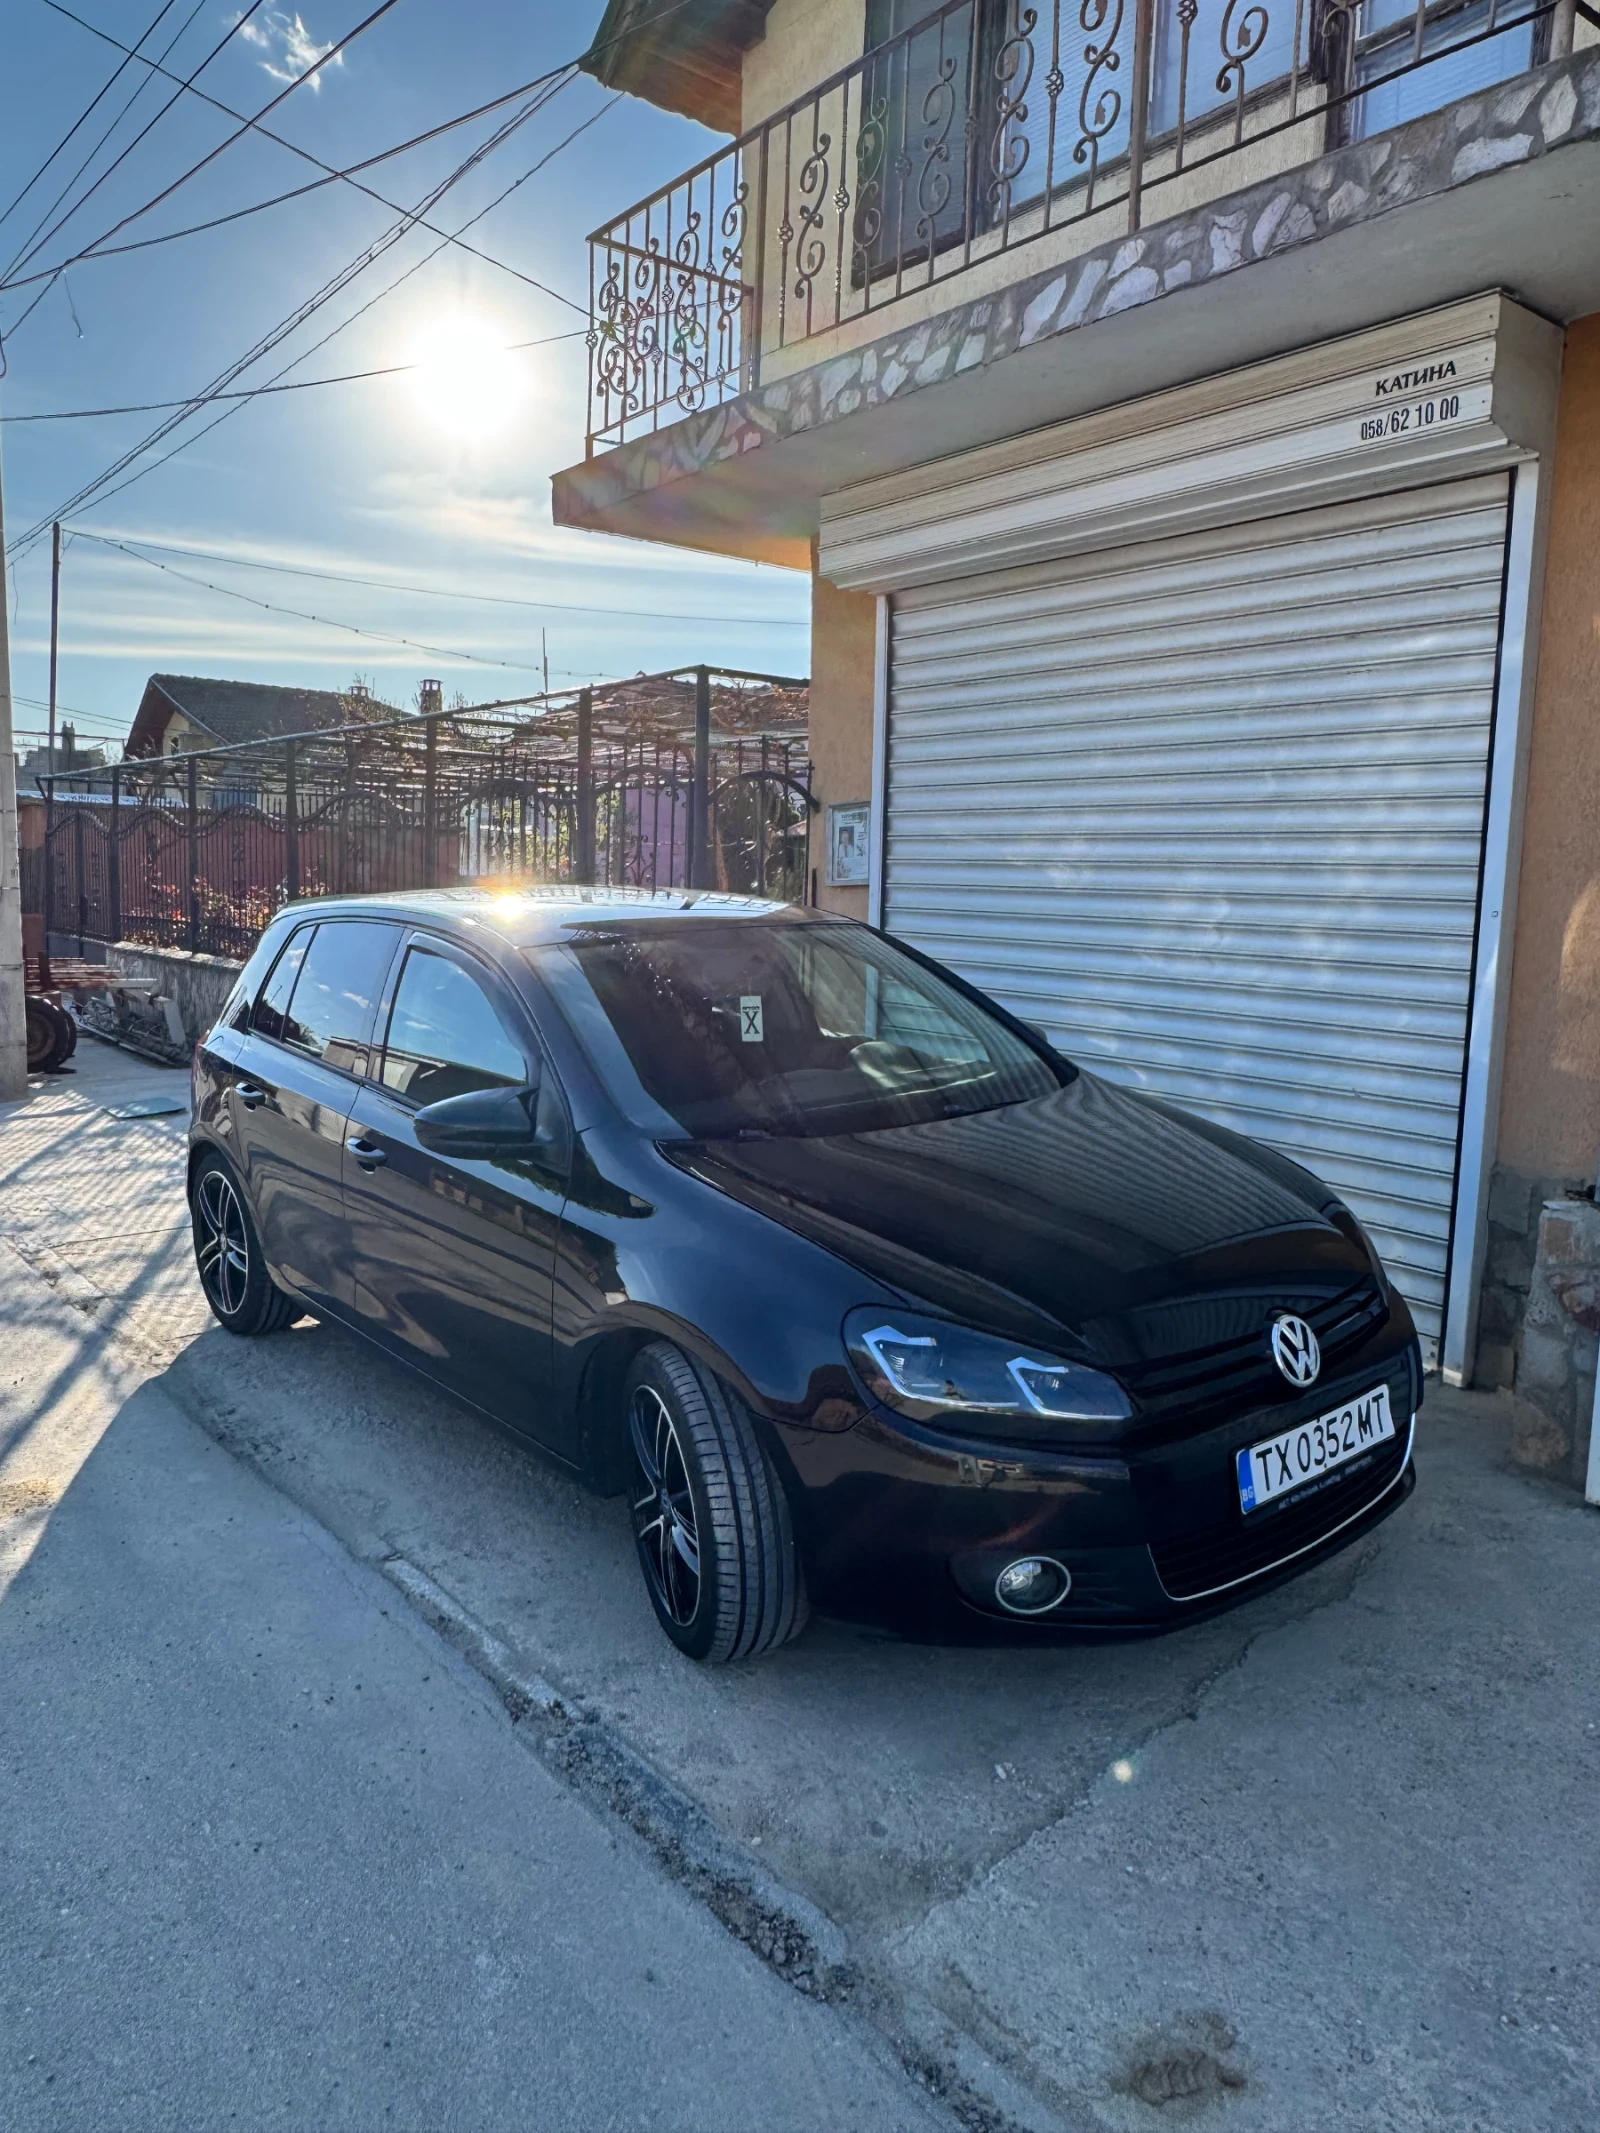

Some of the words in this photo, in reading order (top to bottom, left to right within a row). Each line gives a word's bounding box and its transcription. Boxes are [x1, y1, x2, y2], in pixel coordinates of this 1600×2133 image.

[1375, 360, 1457, 397] КАТИНА
[1361, 408, 1410, 440] 058/62
[1415, 402, 1434, 427] 10
[1440, 395, 1460, 421] 00
[1241, 1486, 1254, 1502] BG
